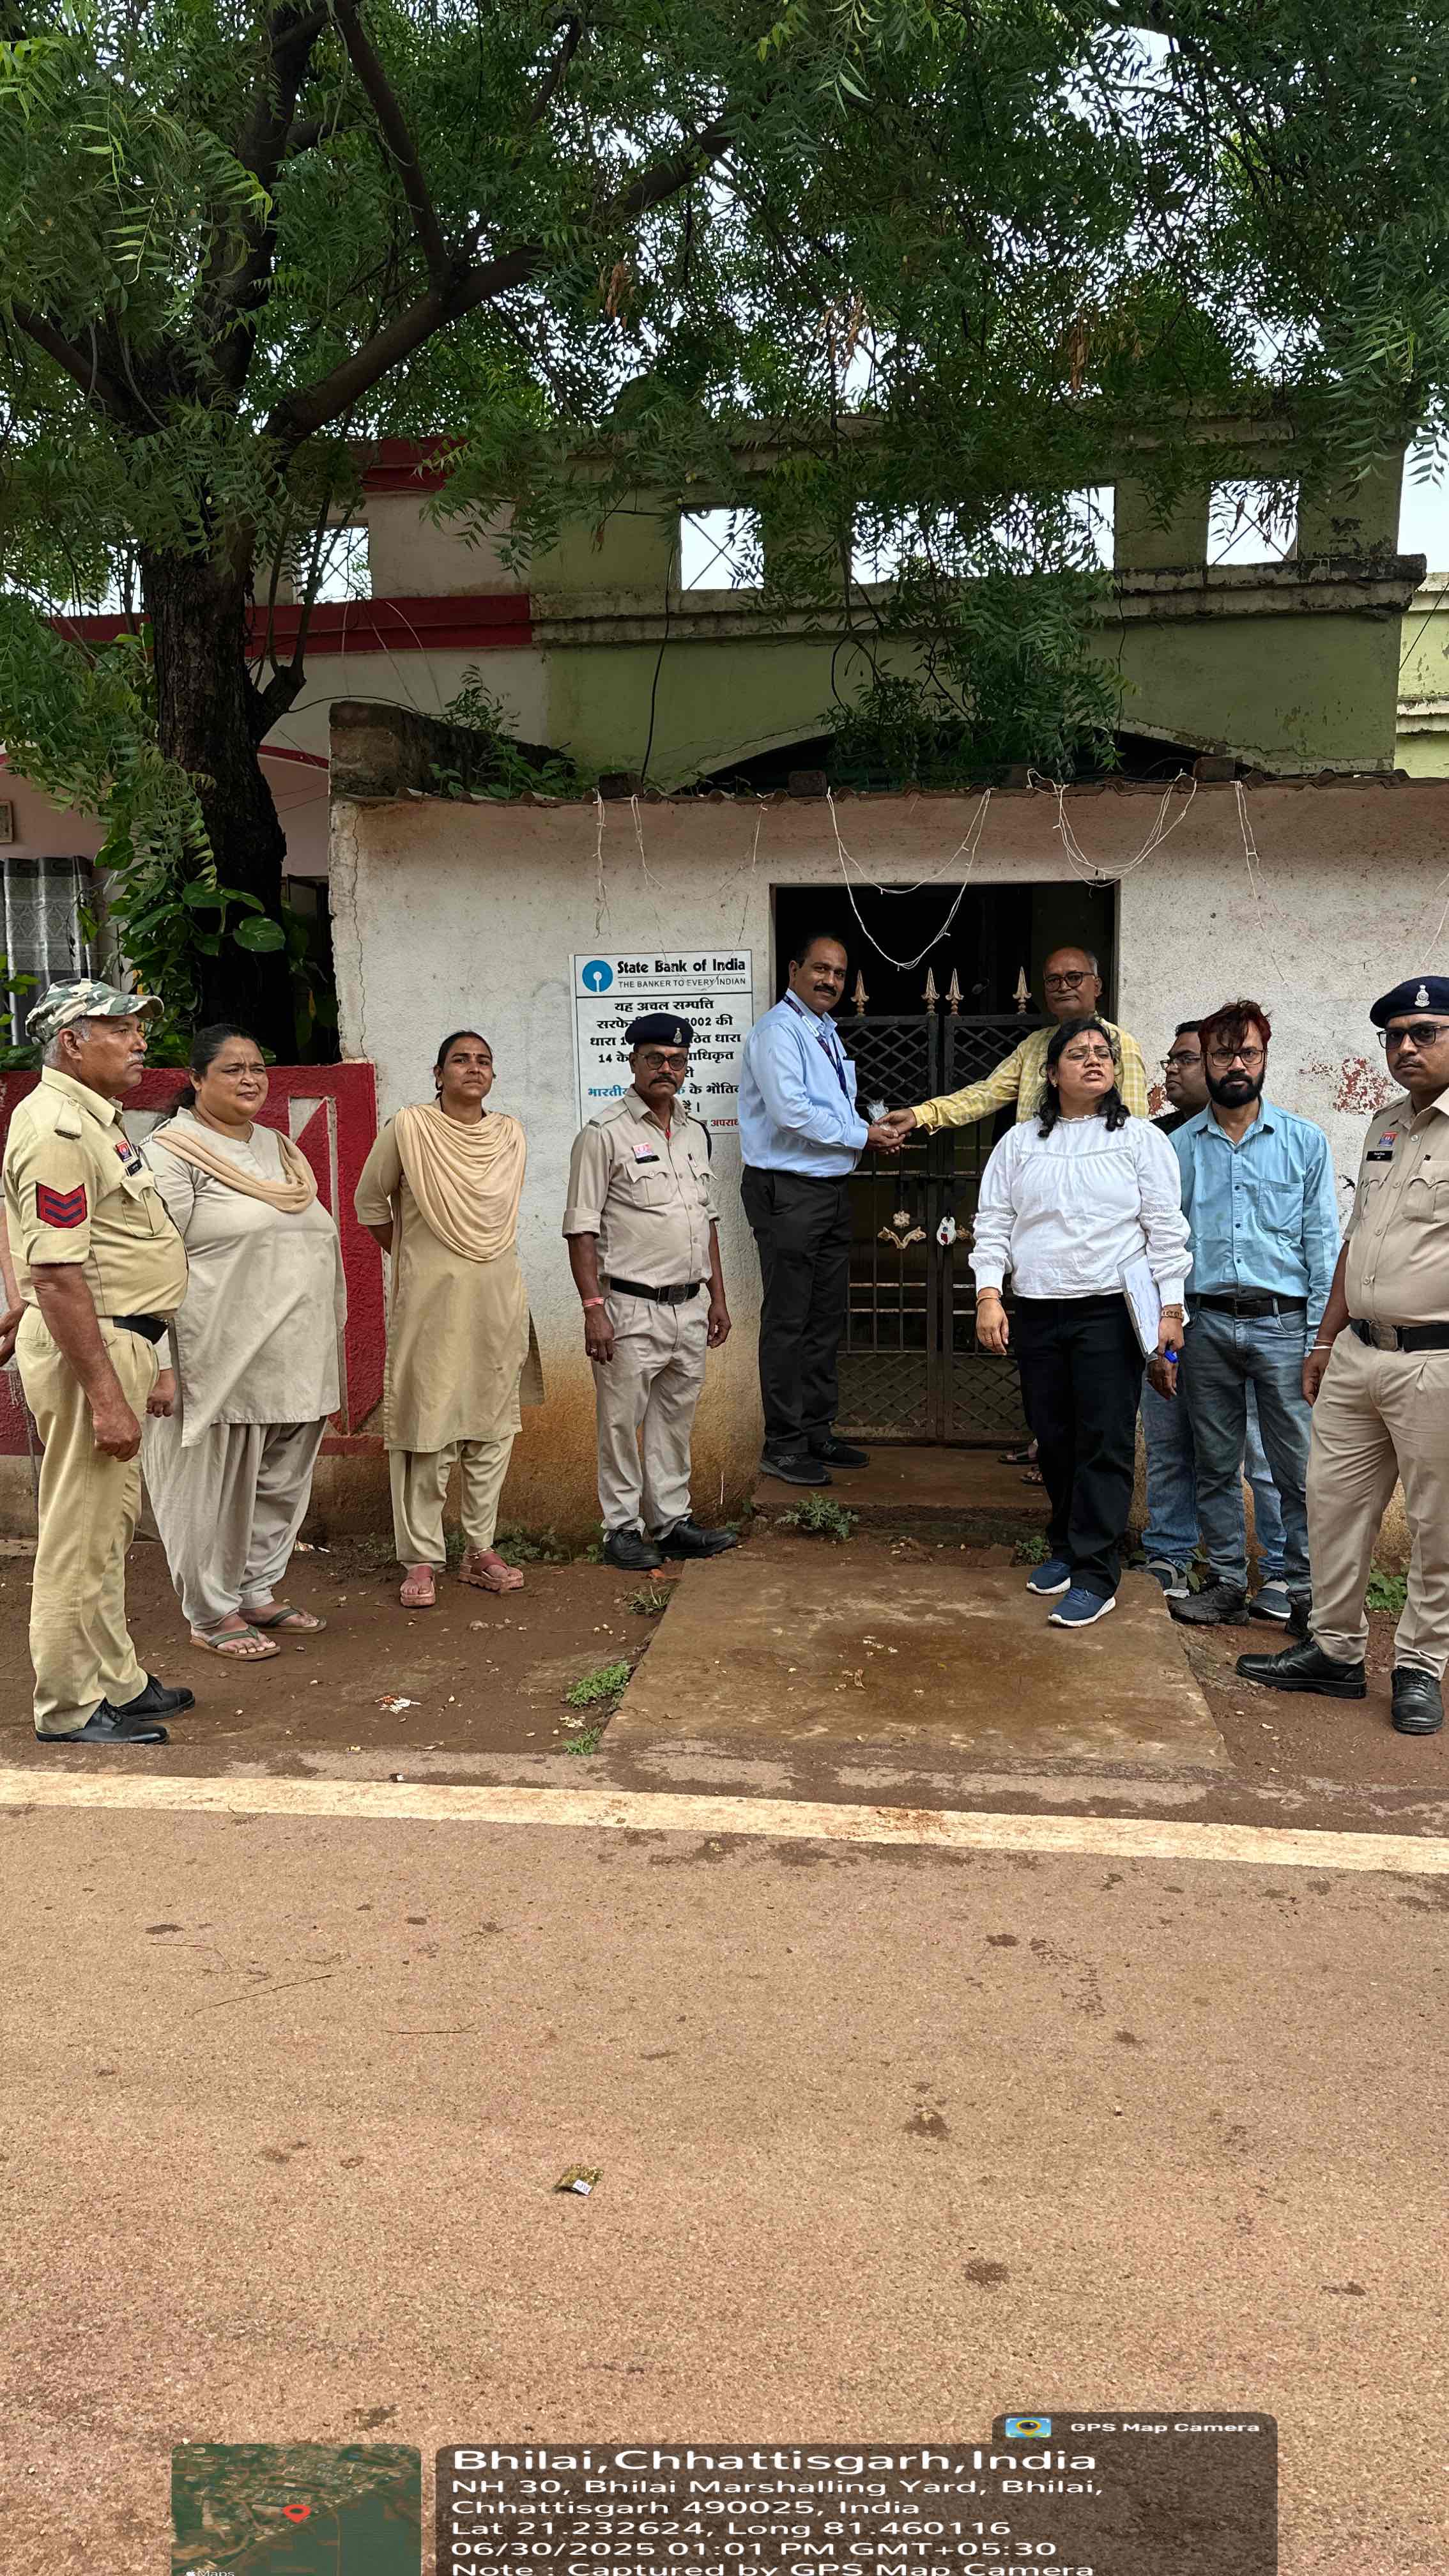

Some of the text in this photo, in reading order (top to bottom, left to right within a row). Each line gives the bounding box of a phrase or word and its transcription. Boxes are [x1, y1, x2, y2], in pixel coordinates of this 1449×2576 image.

[618, 958, 746, 974] State Bank of India
[615, 997, 714, 1012] यह अचल सम्पत्ति
[716, 1014, 733, 1026] की
[590, 1037, 617, 1046] धारा
[690, 1032, 711, 1043] ठित
[716, 1034, 741, 1043] धारा
[599, 1054, 613, 1063] 14
[616, 1051, 629, 1062] के
[689, 1083, 702, 1094] के
